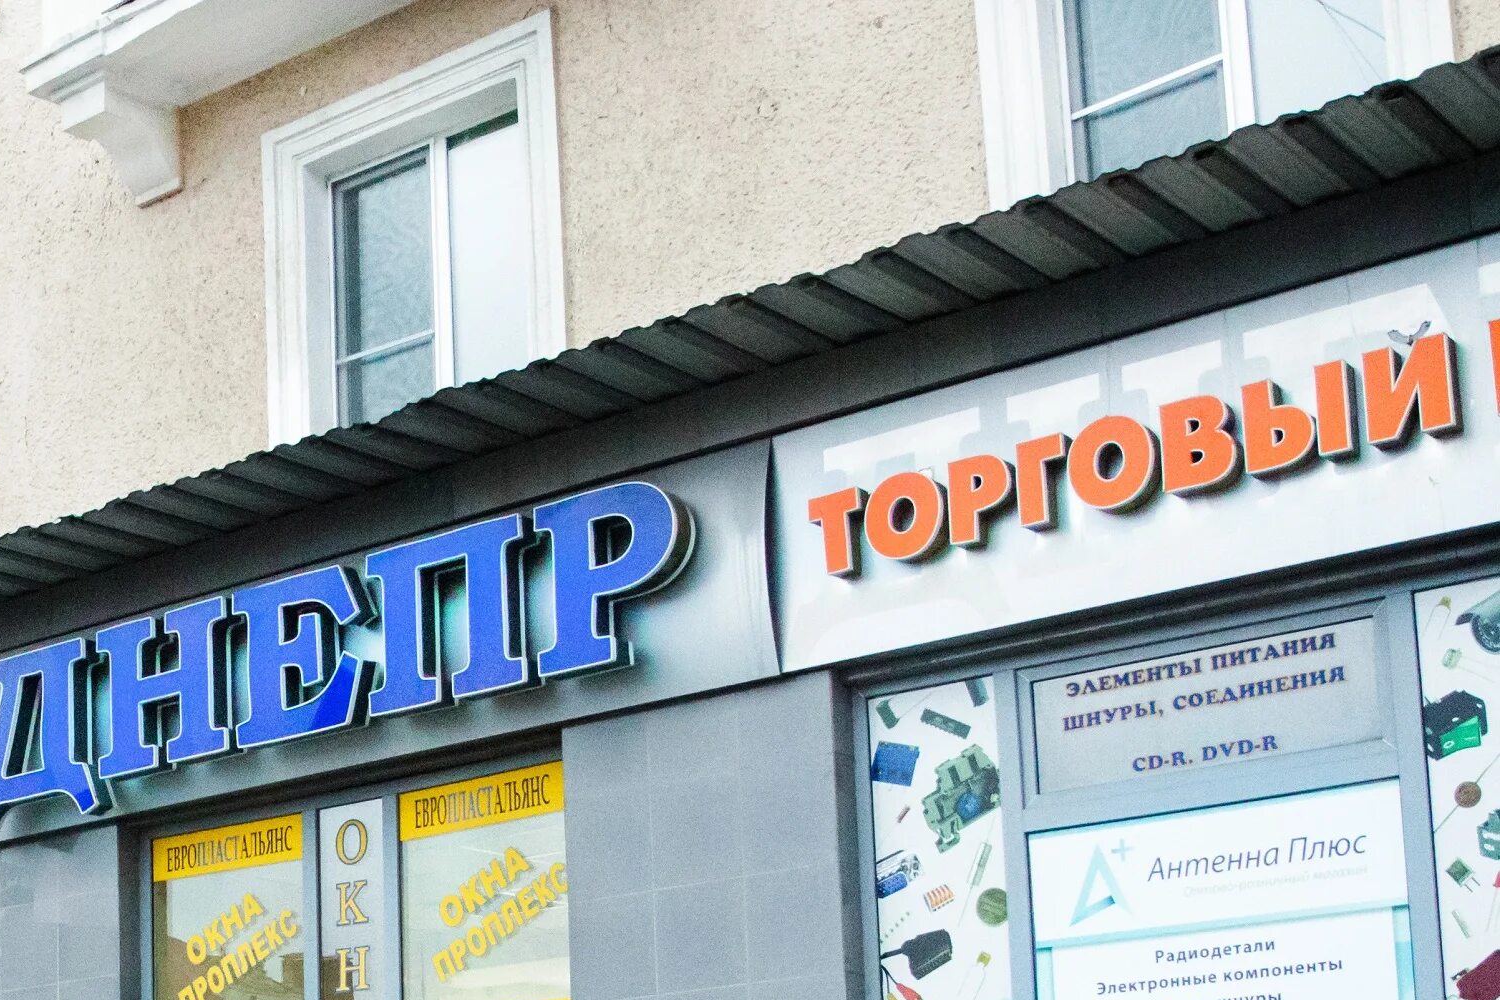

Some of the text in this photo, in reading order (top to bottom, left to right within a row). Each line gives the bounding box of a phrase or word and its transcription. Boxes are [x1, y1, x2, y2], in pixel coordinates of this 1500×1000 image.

[808, 320, 1458, 577] ТОРГОВЫЙ
[1065, 632, 1337, 698] ЭЛЕМЕНТЫ ПИТАНИЯ
[1062, 665, 1346, 732] ШНУРЫ, СОЕДИНЕНИЯ
[1201, 735, 1279, 762] DVD-R
[414, 773, 551, 830] ЕВРОПЛАСТАЛЬЯНС
[166, 825, 293, 873] ЕВРОПЛАСТАЛЬЯНС
[1147, 834, 1368, 883] Антенна Плюс
[438, 847, 531, 929] ОКНА
[186, 892, 264, 966] ОКНА
[431, 862, 569, 984] ПРОПЛЕКС
[1155, 940, 1276, 963] Радиодетали
[1096, 959, 1343, 995] Электронные компоненты
